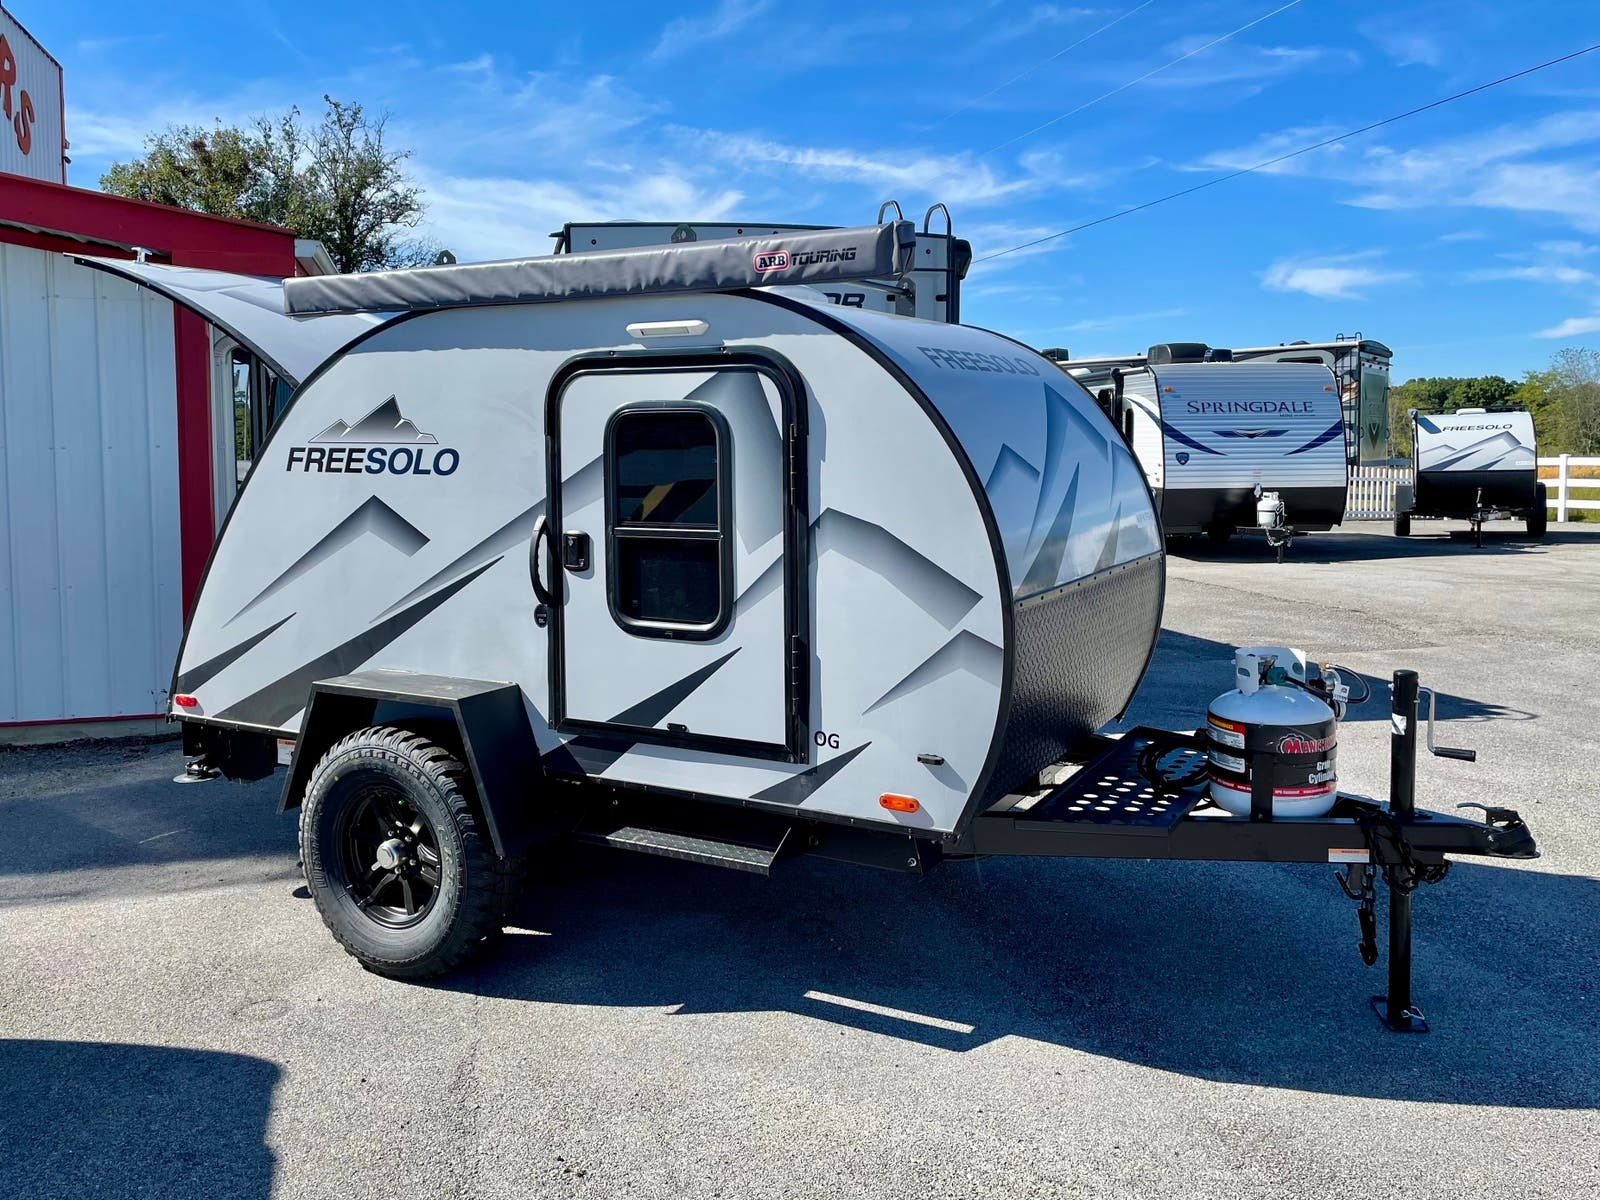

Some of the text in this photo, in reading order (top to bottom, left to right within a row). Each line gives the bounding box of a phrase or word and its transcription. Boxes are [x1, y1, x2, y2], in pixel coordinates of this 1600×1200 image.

[758, 247, 857, 268] ARB TOURING
[916, 346, 1040, 376] FREESOLO
[1187, 400, 1314, 414] SPRINGDALE
[1442, 423, 1513, 432] FREESOLO
[286, 447, 460, 476] FREESOLO
[814, 731, 840, 749] OG
